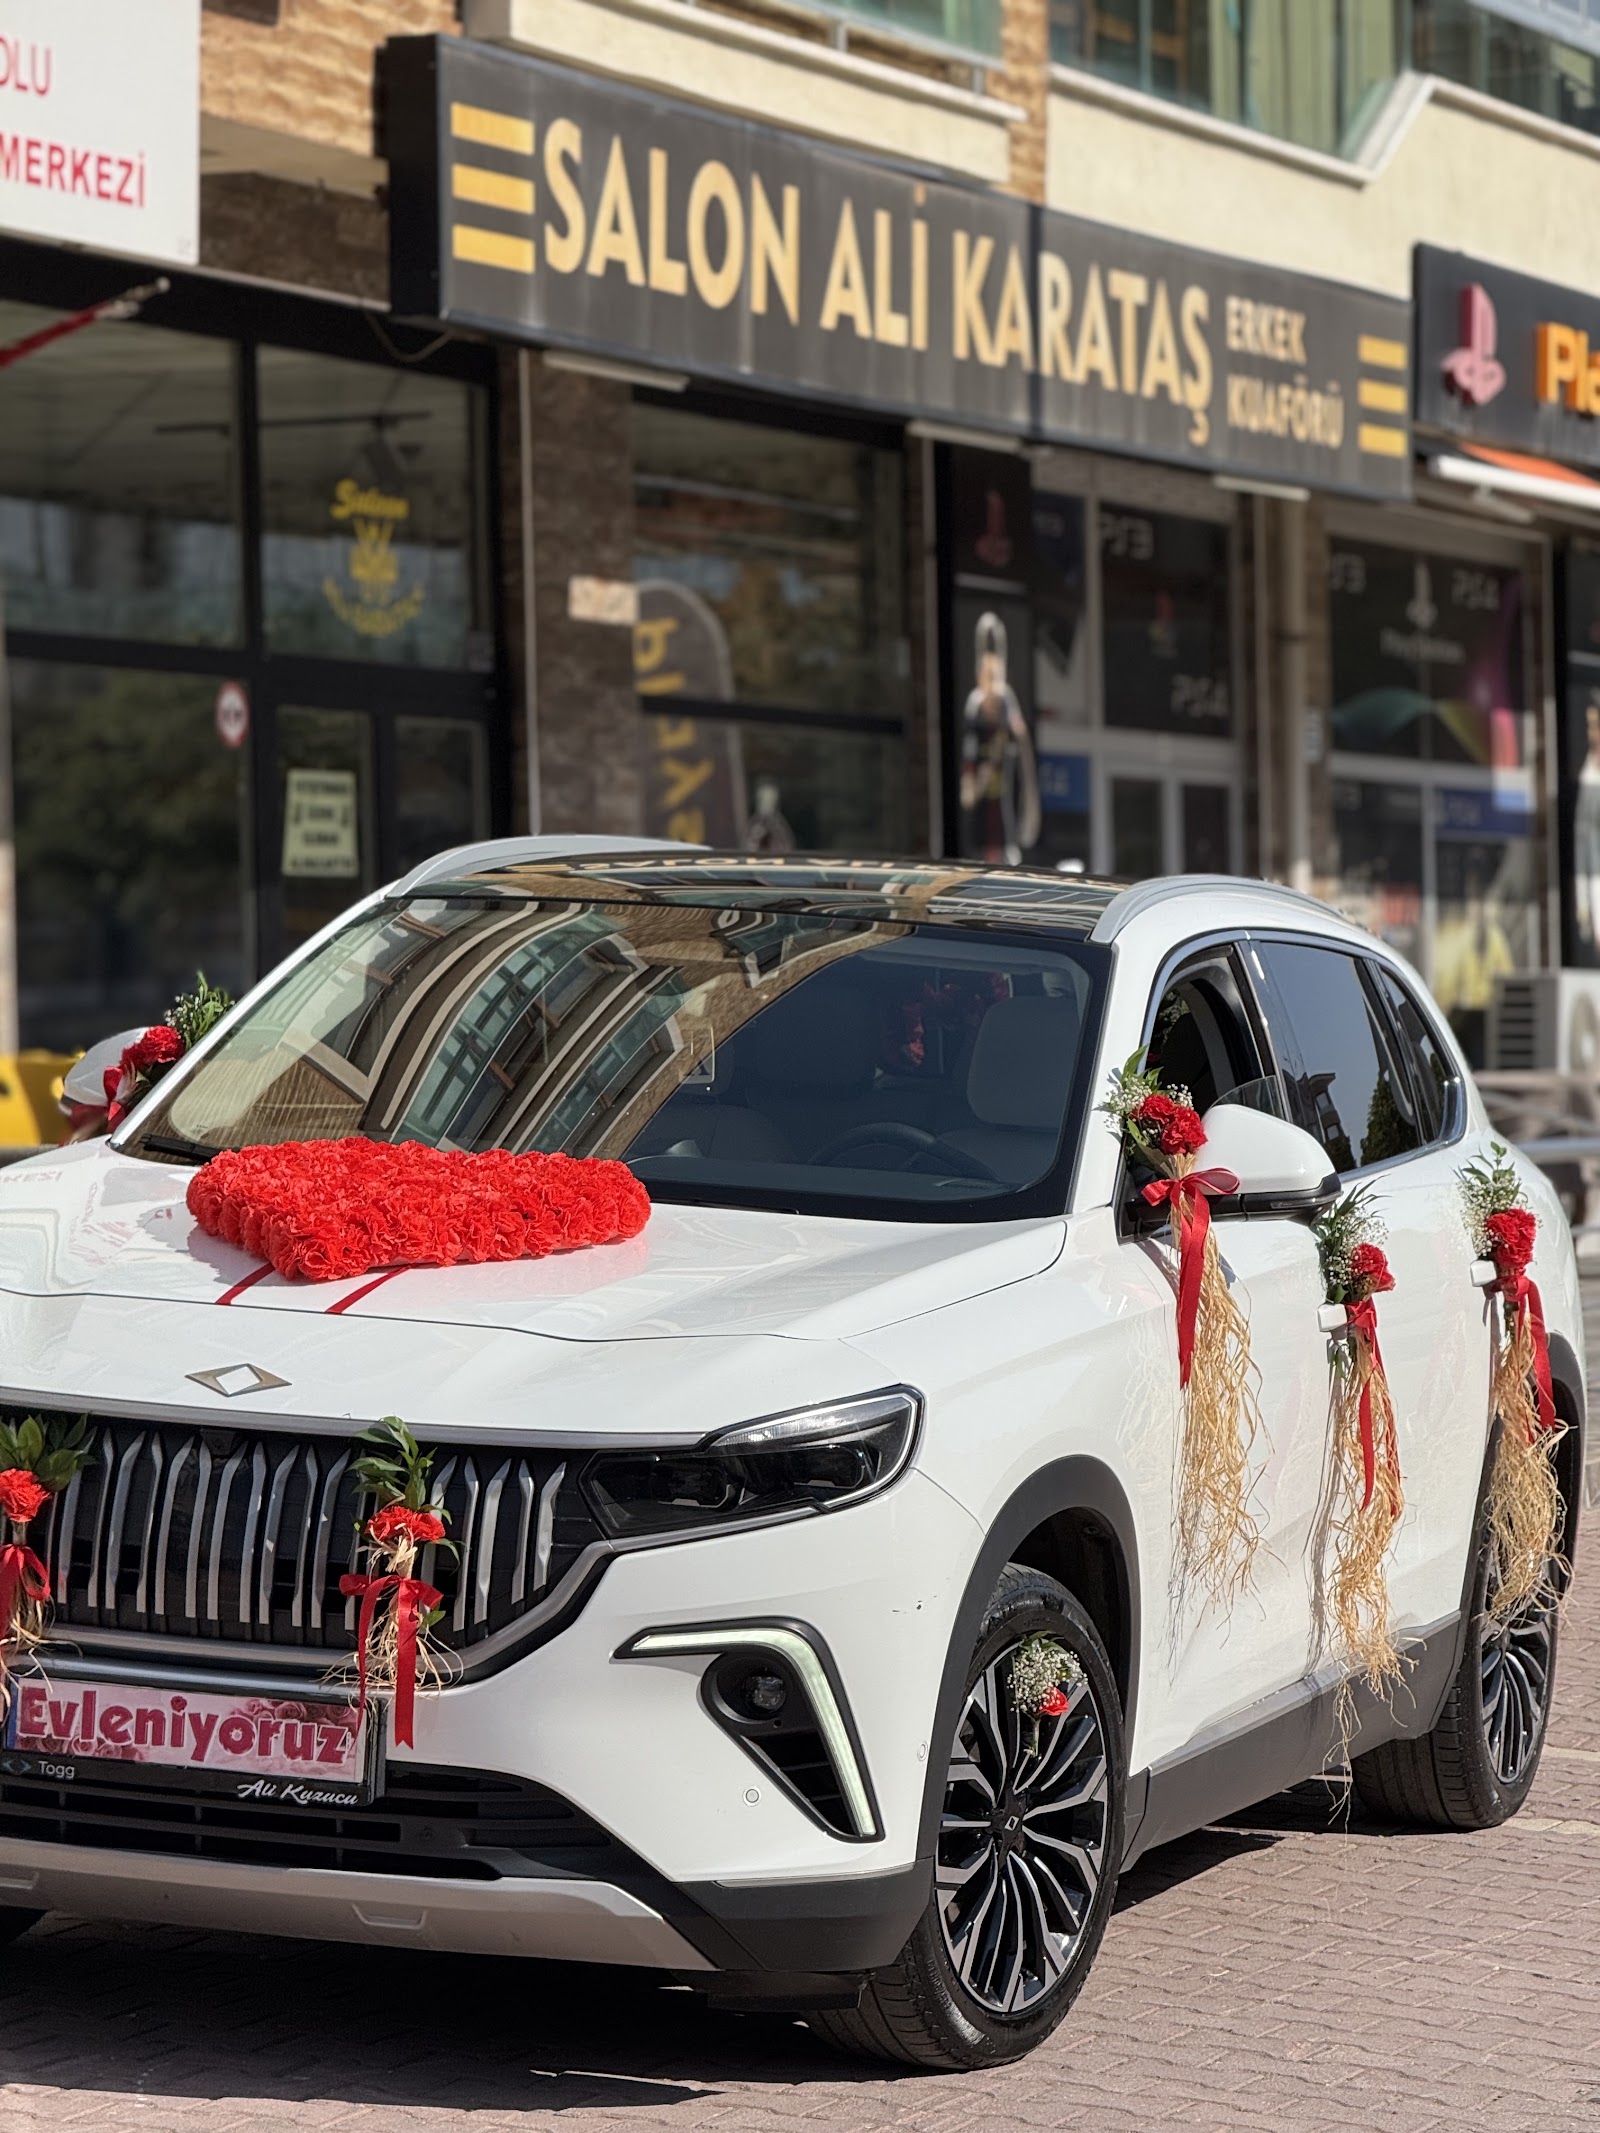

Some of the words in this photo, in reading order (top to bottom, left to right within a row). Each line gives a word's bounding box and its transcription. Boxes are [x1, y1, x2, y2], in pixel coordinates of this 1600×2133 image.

[543, 116, 800, 328] SALON
[819, 183, 929, 352] ALİ
[953, 229, 1213, 447] KARATAŞ
[1225, 294, 1307, 368] ERKEK
[1227, 372, 1345, 450] KUAFÖRÜ
[18, 1685, 349, 1766] Evleniyoruz
[38, 1760, 76, 1780] Togg
[237, 1779, 277, 1798] Ali
[280, 1784, 359, 1805] Kuzucu
